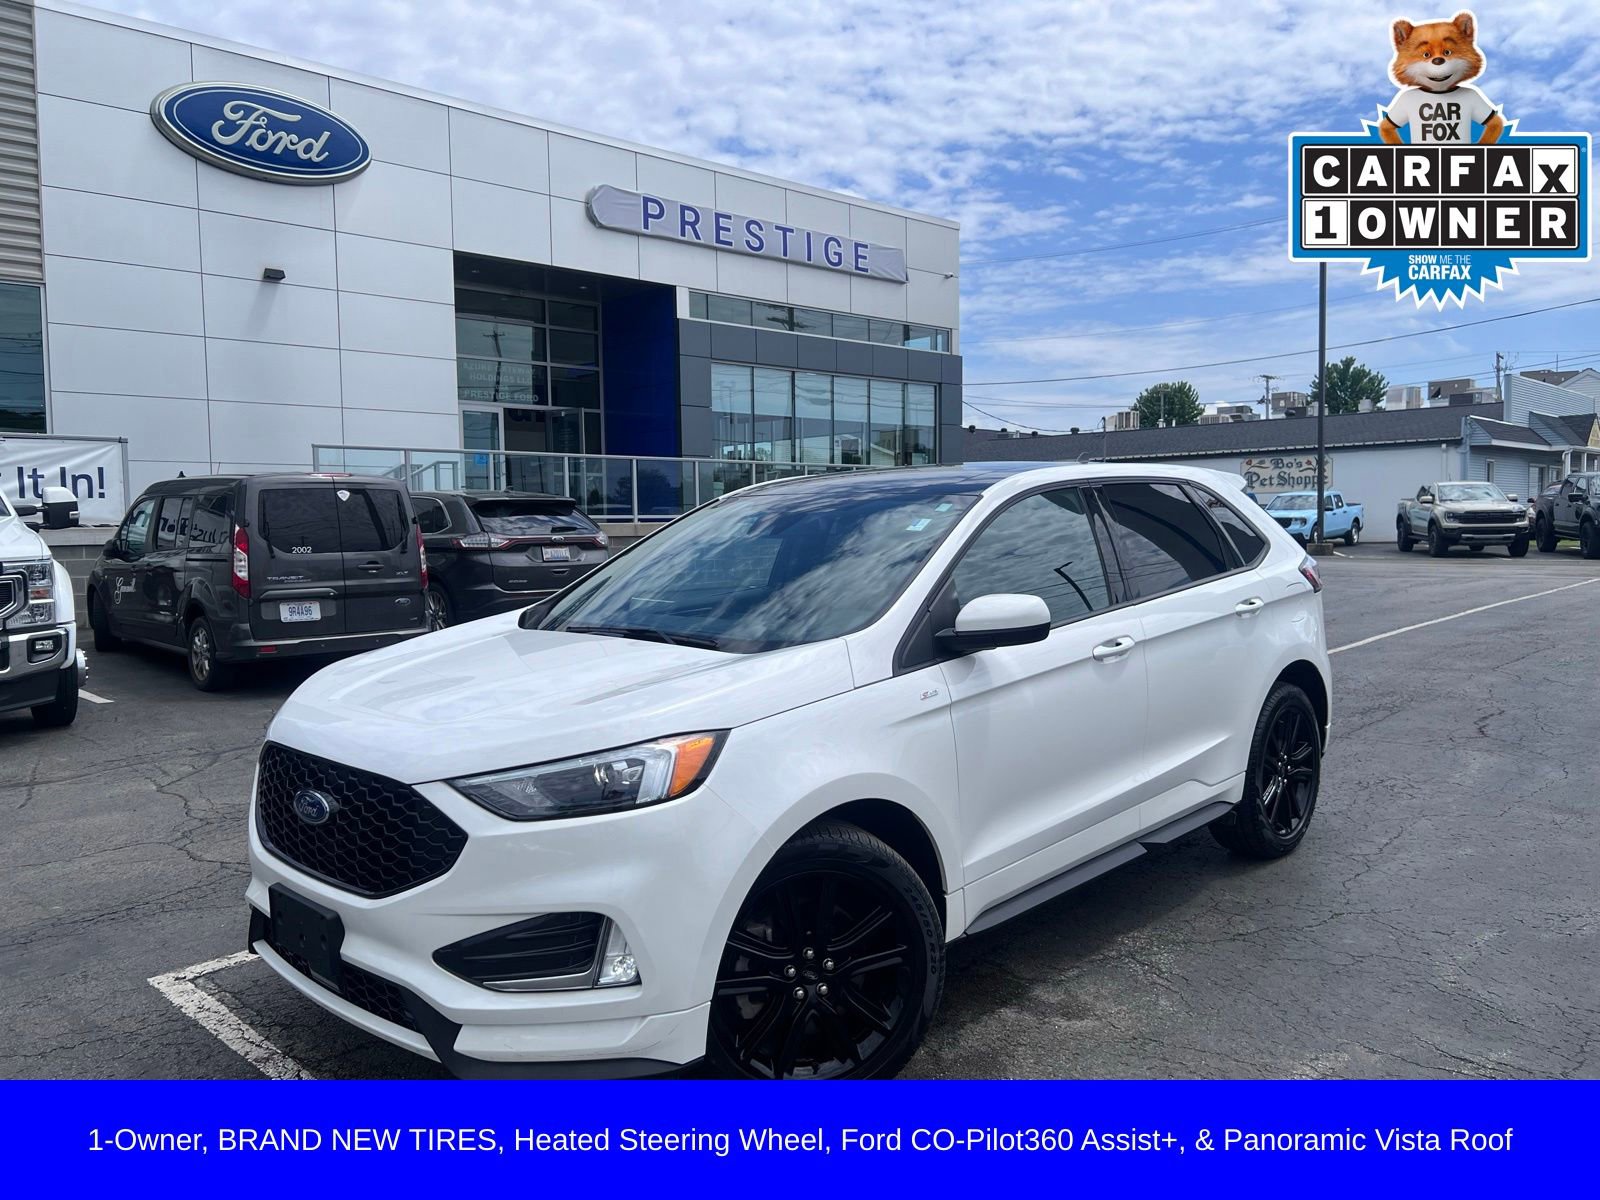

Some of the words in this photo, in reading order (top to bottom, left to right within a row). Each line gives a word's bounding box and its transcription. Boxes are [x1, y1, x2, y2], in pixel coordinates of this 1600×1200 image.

[211, 100, 331, 162] Ford
[641, 195, 869, 273] PRESTIGE
[1270, 458, 1303, 470] Bo's
[17, 466, 44, 499] It
[60, 466, 105, 499] In!
[1244, 471, 1275, 489] Pet
[291, 546, 312, 554] 2002
[288, 605, 313, 617] 9R4A96
[298, 795, 321, 817] Ford
